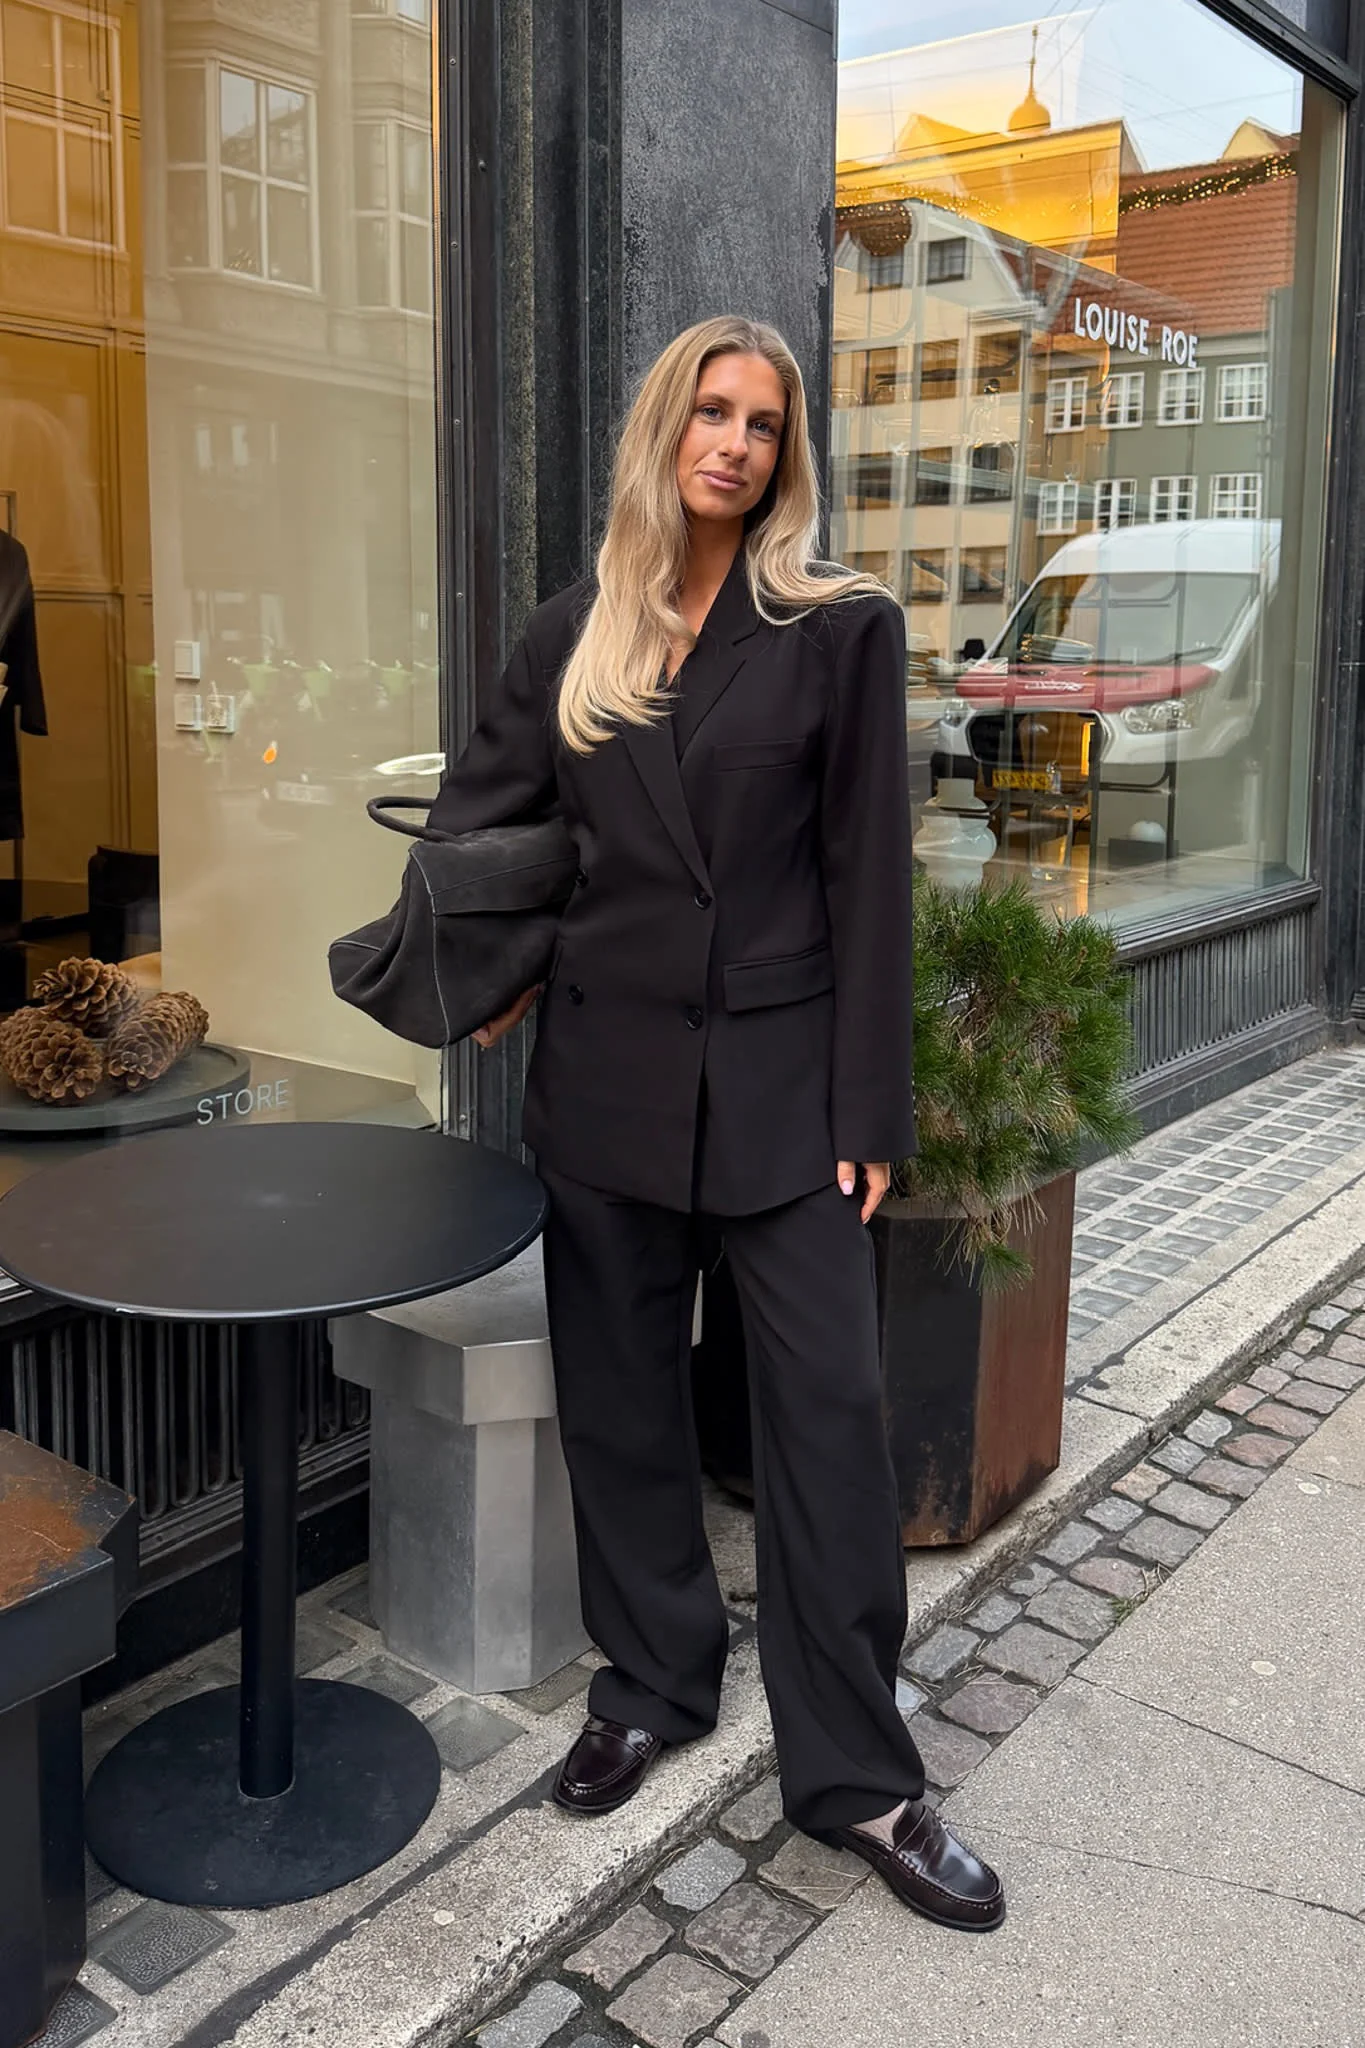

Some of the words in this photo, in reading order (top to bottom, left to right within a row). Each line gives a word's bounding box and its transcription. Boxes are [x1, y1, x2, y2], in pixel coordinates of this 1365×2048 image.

[1075, 297, 1150, 355] LOUISE
[1161, 325, 1198, 368] ROE
[196, 1079, 289, 1125] STORE
